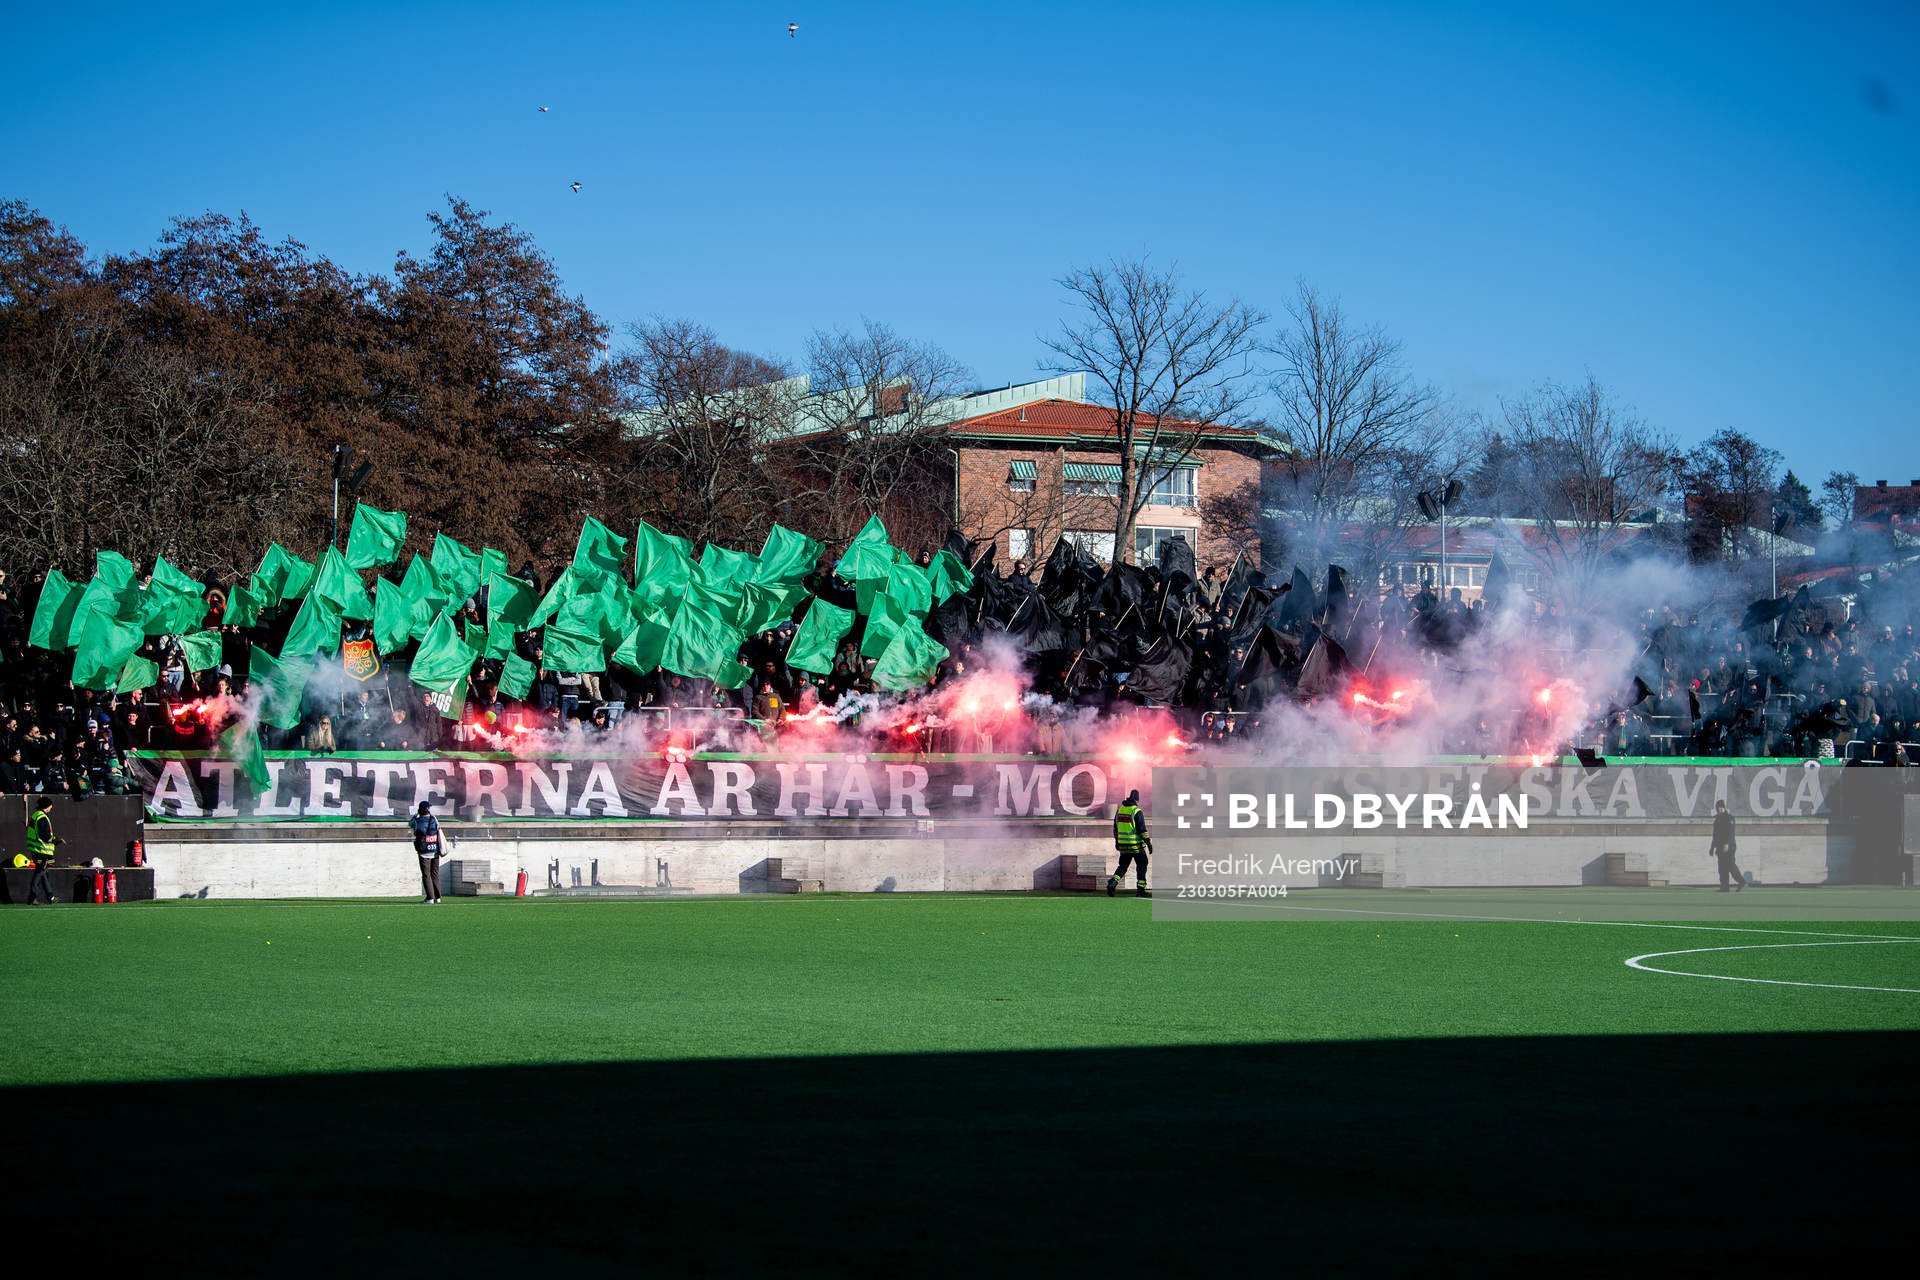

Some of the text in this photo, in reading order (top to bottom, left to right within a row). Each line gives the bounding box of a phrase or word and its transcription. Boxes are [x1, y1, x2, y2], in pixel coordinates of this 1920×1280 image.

[150, 761, 628, 817] ATLETERNA
[650, 753, 757, 816] ÄR
[774, 754, 930, 817] HÄR
[1520, 765, 1646, 817] SKA
[1668, 767, 1733, 817] VI
[1750, 760, 1831, 817] GÅ
